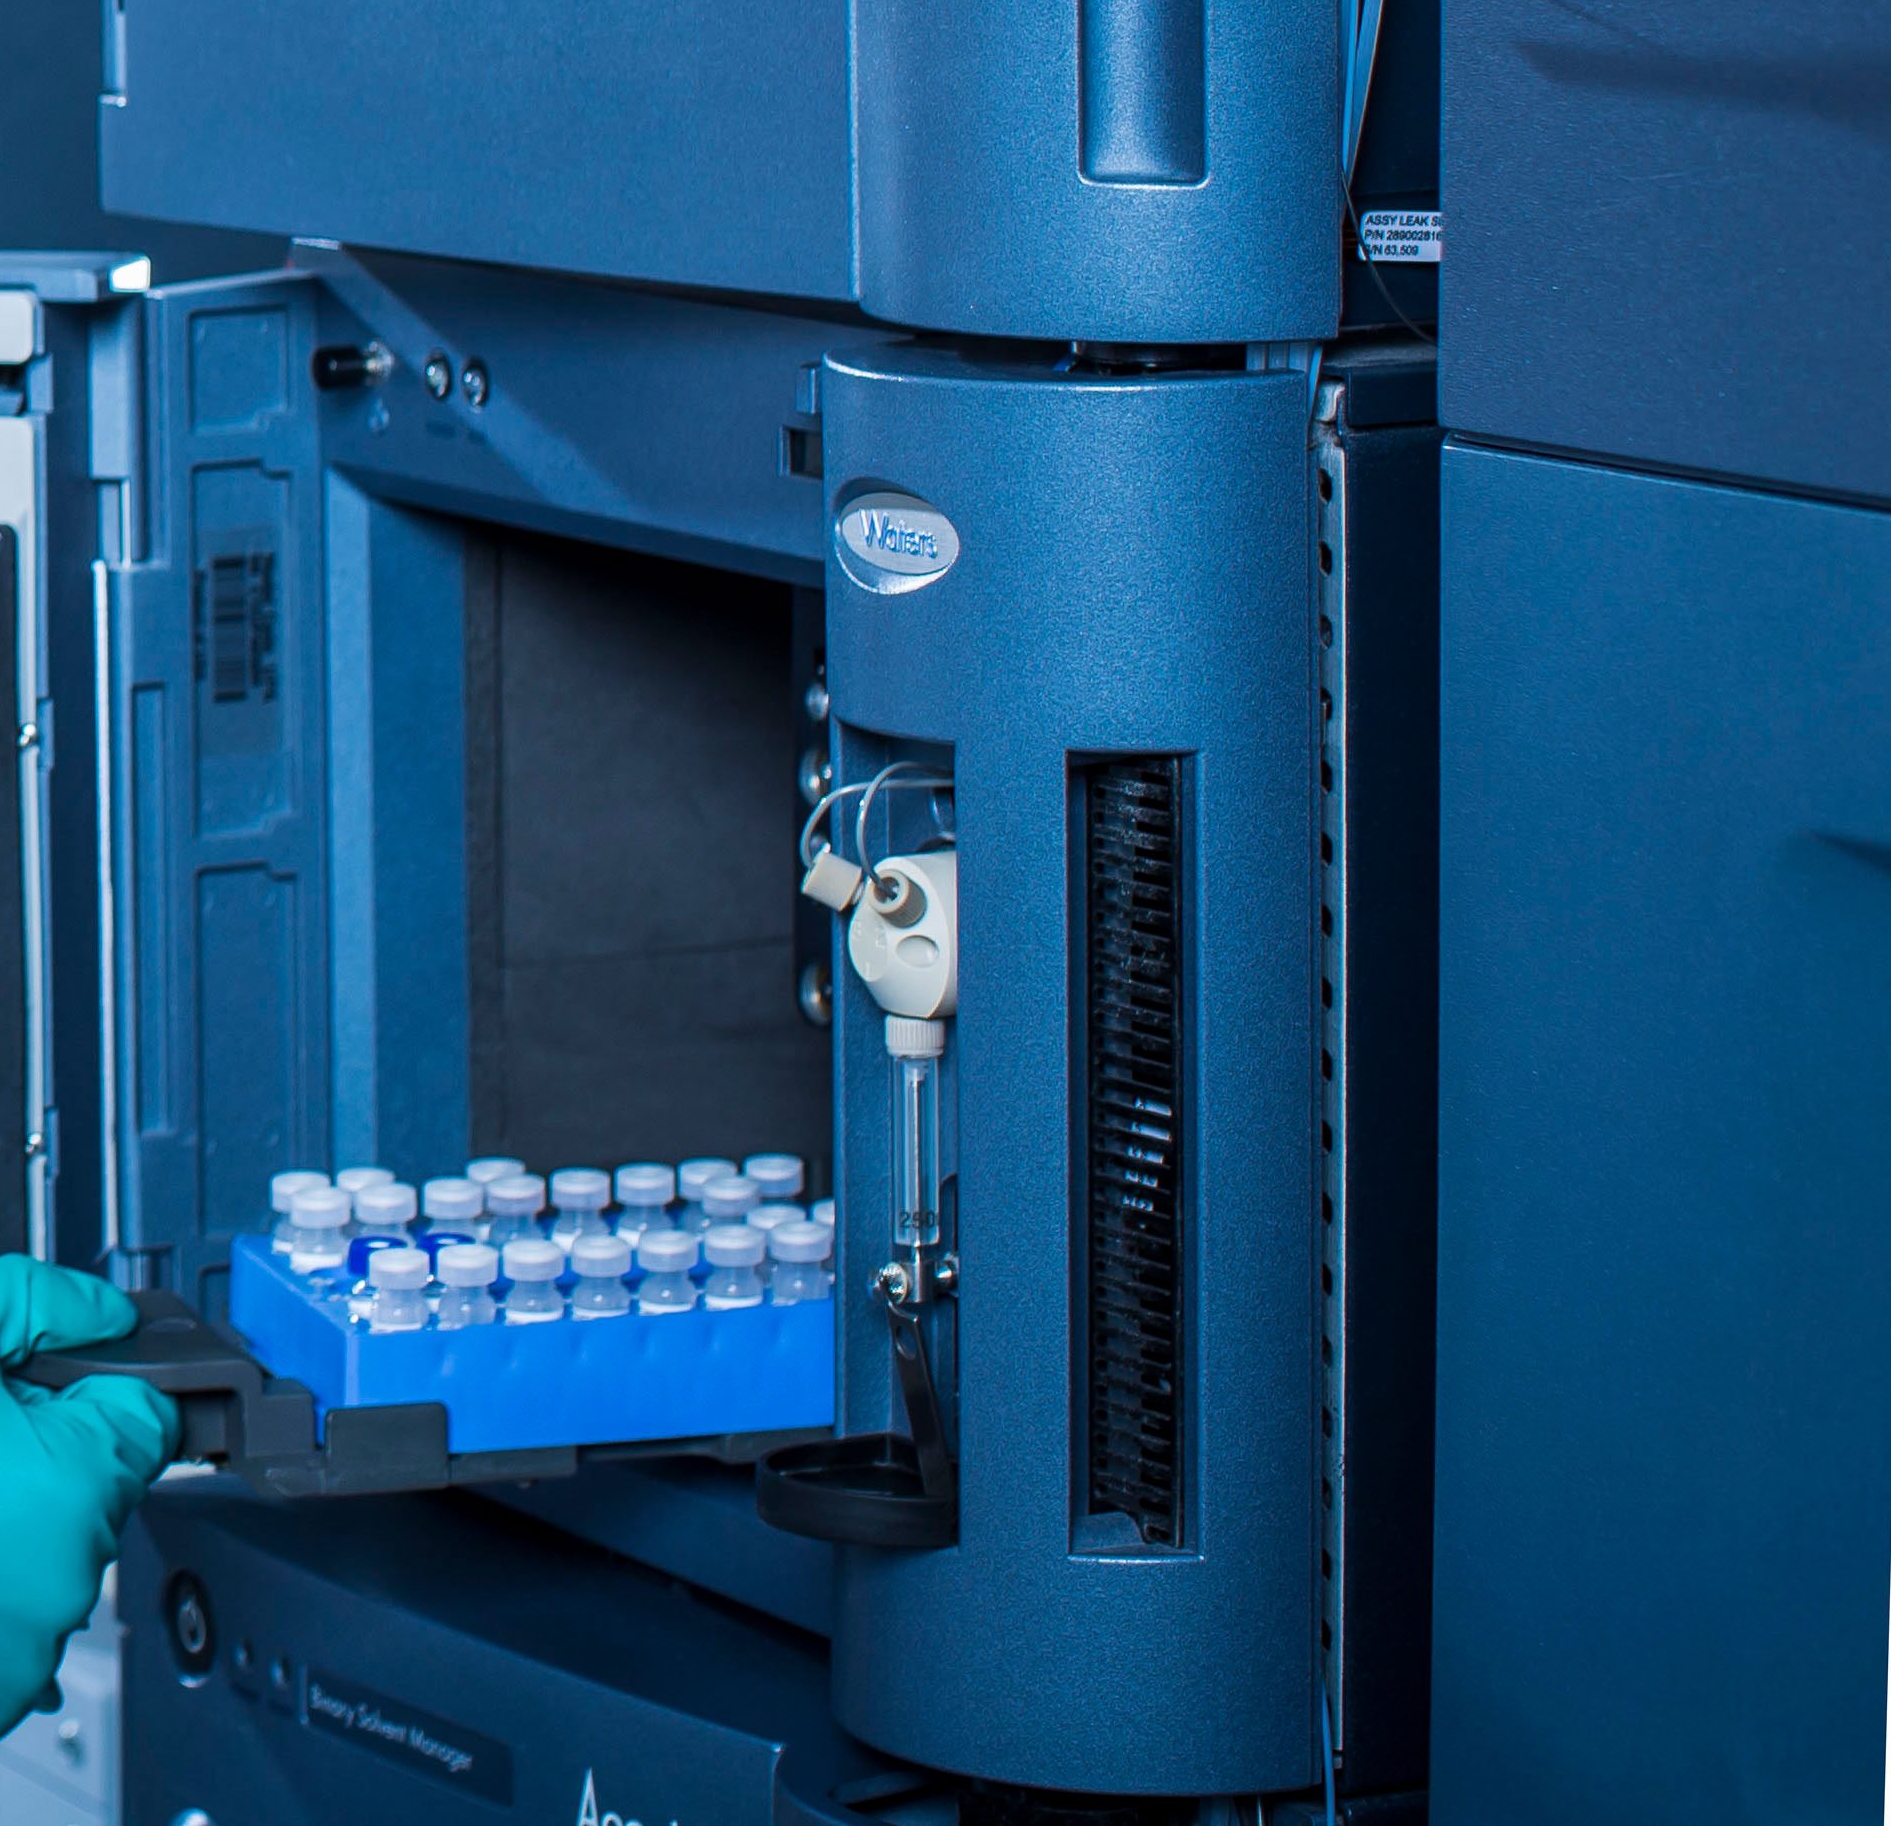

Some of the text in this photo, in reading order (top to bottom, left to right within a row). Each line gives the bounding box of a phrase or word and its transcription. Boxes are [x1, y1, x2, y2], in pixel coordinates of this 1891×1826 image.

[1365, 214, 1397, 226] ASSY
[1399, 215, 1430, 227] LEAK
[859, 508, 939, 560] Waters
